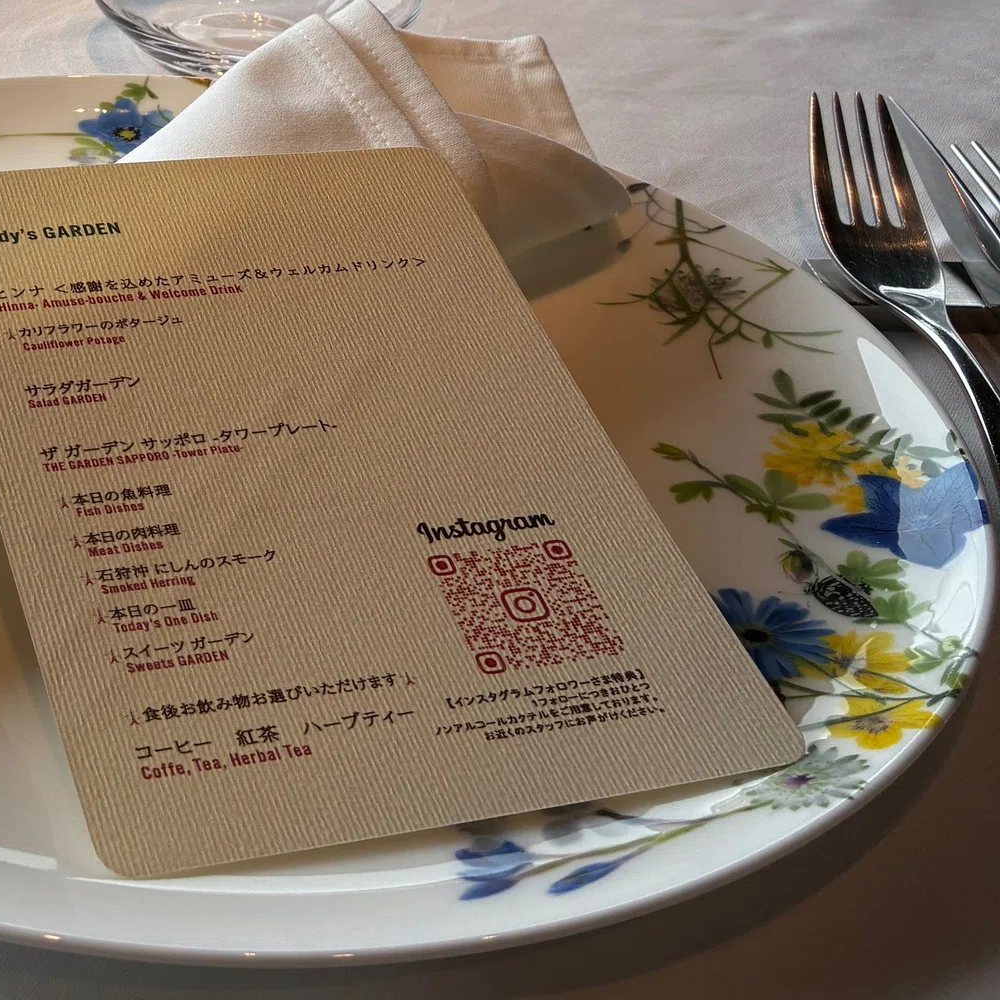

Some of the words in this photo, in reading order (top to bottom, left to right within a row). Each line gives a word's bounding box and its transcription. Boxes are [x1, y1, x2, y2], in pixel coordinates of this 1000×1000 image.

[42, 222, 121, 240] GARDEN
[43, 292, 134, 309] Amuse-bouche
[138, 290, 147, 301] &
[149, 286, 207, 301] Welcome
[210, 284, 244, 296] Drink
[18, 314, 184, 338] カリフラワーのポタージュ
[23, 338, 85, 352] Cauliflower
[86, 334, 126, 348] Potage
[25, 376, 141, 398] サラダガーデン
[28, 398, 61, 409] Salad
[62, 392, 108, 406] GARDEN
[64, 440, 135, 460] ガーデン
[141, 432, 207, 451] サッポロ
[43, 461, 70, 473] THE
[68, 456, 115, 470] GARDEN
[117, 451, 171, 466] SAPPORO
[172, 447, 209, 460] -Tower
[72, 483, 173, 507] 本日の魚料理
[76, 506, 103, 518] Fish
[104, 501, 145, 515] Dishes
[84, 522, 181, 546] 本日の肉料理
[417, 513, 556, 543] Instagram
[87, 546, 120, 558] Meat
[121, 540, 165, 554] Dishes
[96, 564, 149, 583] 石狩沖
[154, 549, 277, 575] にしんのスモーク
[101, 581, 150, 596] Smoked
[150, 575, 196, 590] Herring
[109, 598, 196, 622] 本日の一皿
[112, 617, 162, 634] Today's
[164, 614, 189, 627] One
[191, 610, 220, 624] Dish
[123, 643, 185, 660] スイーツ
[190, 631, 255, 652] ガーデン
[126, 660, 176, 674] Sweets
[177, 650, 230, 667] GARDEN
[142, 672, 398, 723] 食後お飲み物お選びいただけます
[135, 740, 212, 760] コーヒー
[235, 725, 280, 747] 紅茶
[140, 763, 192, 780] Coffe,
[192, 755, 227, 772] Tea,
[229, 746, 283, 767] Herbal
[282, 744, 313, 758] Tea
